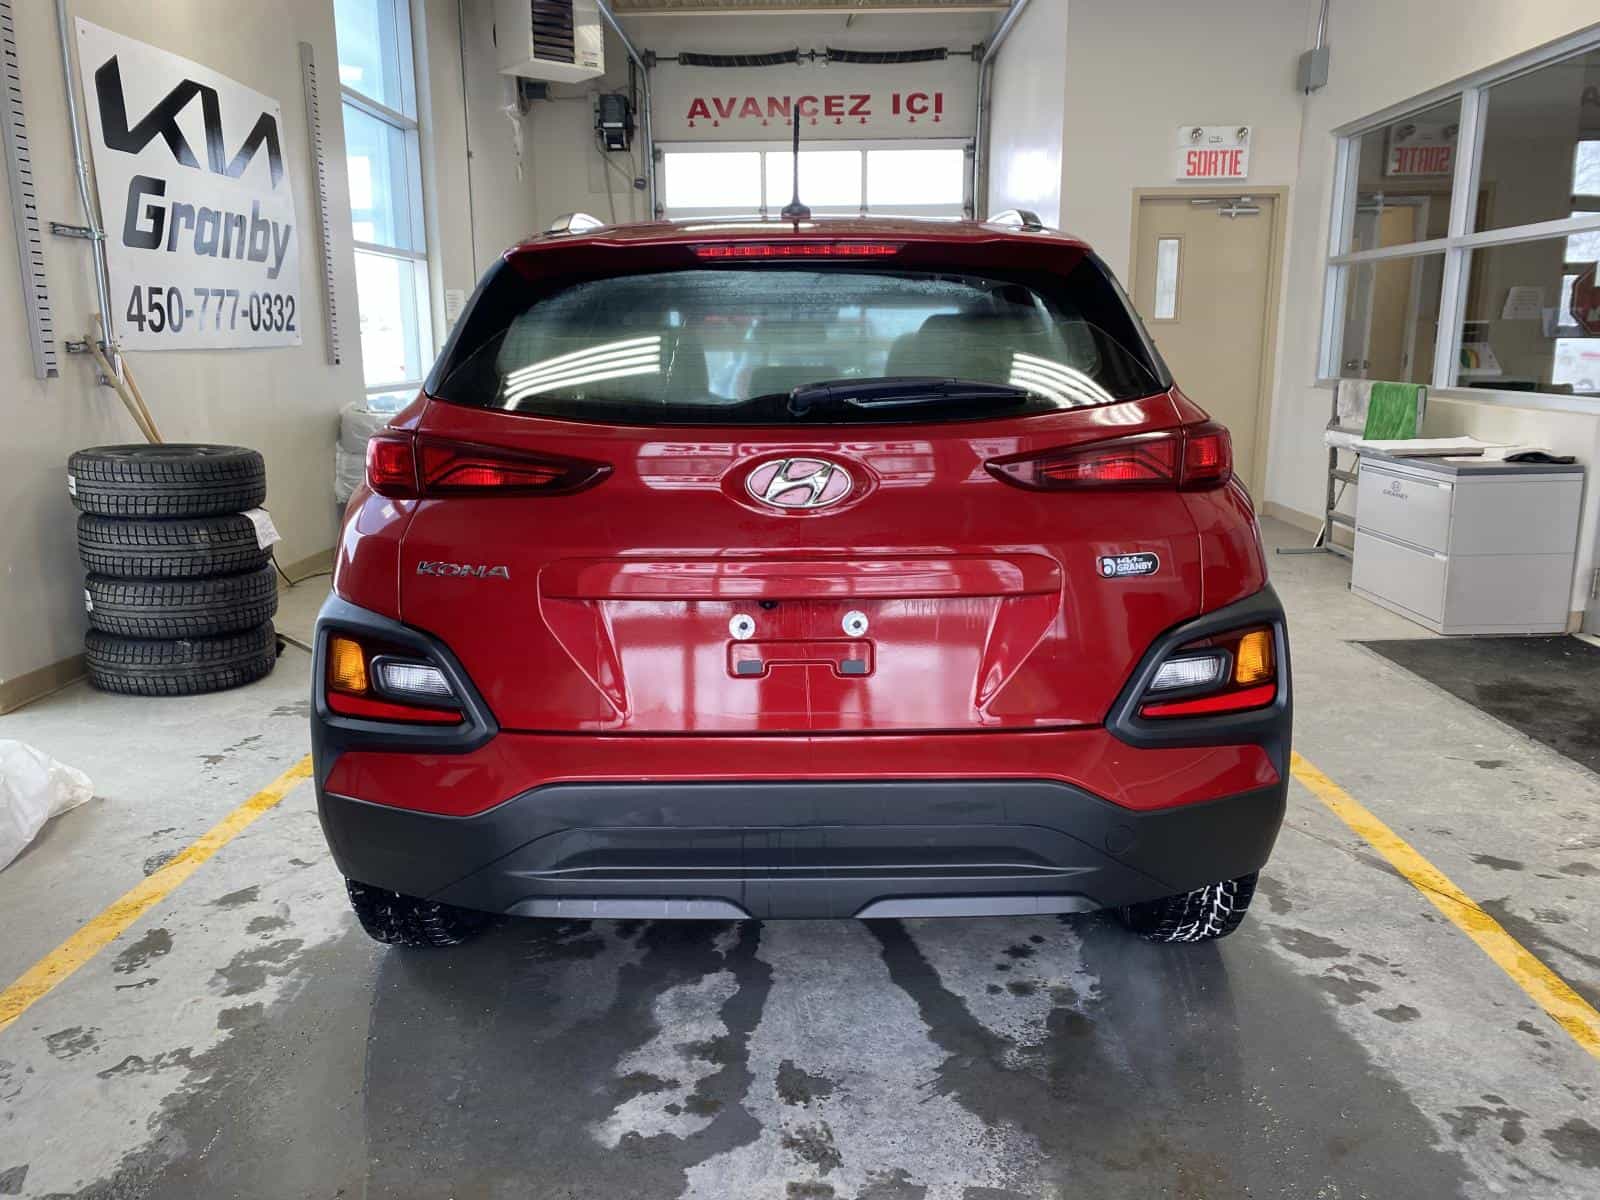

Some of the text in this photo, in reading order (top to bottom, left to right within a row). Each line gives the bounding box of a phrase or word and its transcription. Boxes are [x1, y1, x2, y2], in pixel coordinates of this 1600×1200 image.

[687, 92, 943, 119] AVANCEZ ICI
[1186, 149, 1243, 176] SORTIE
[122, 174, 292, 280] Granby
[126, 285, 296, 333] 450-777-0332
[416, 560, 510, 580] KONA
[1117, 561, 1152, 571] GRANBY
